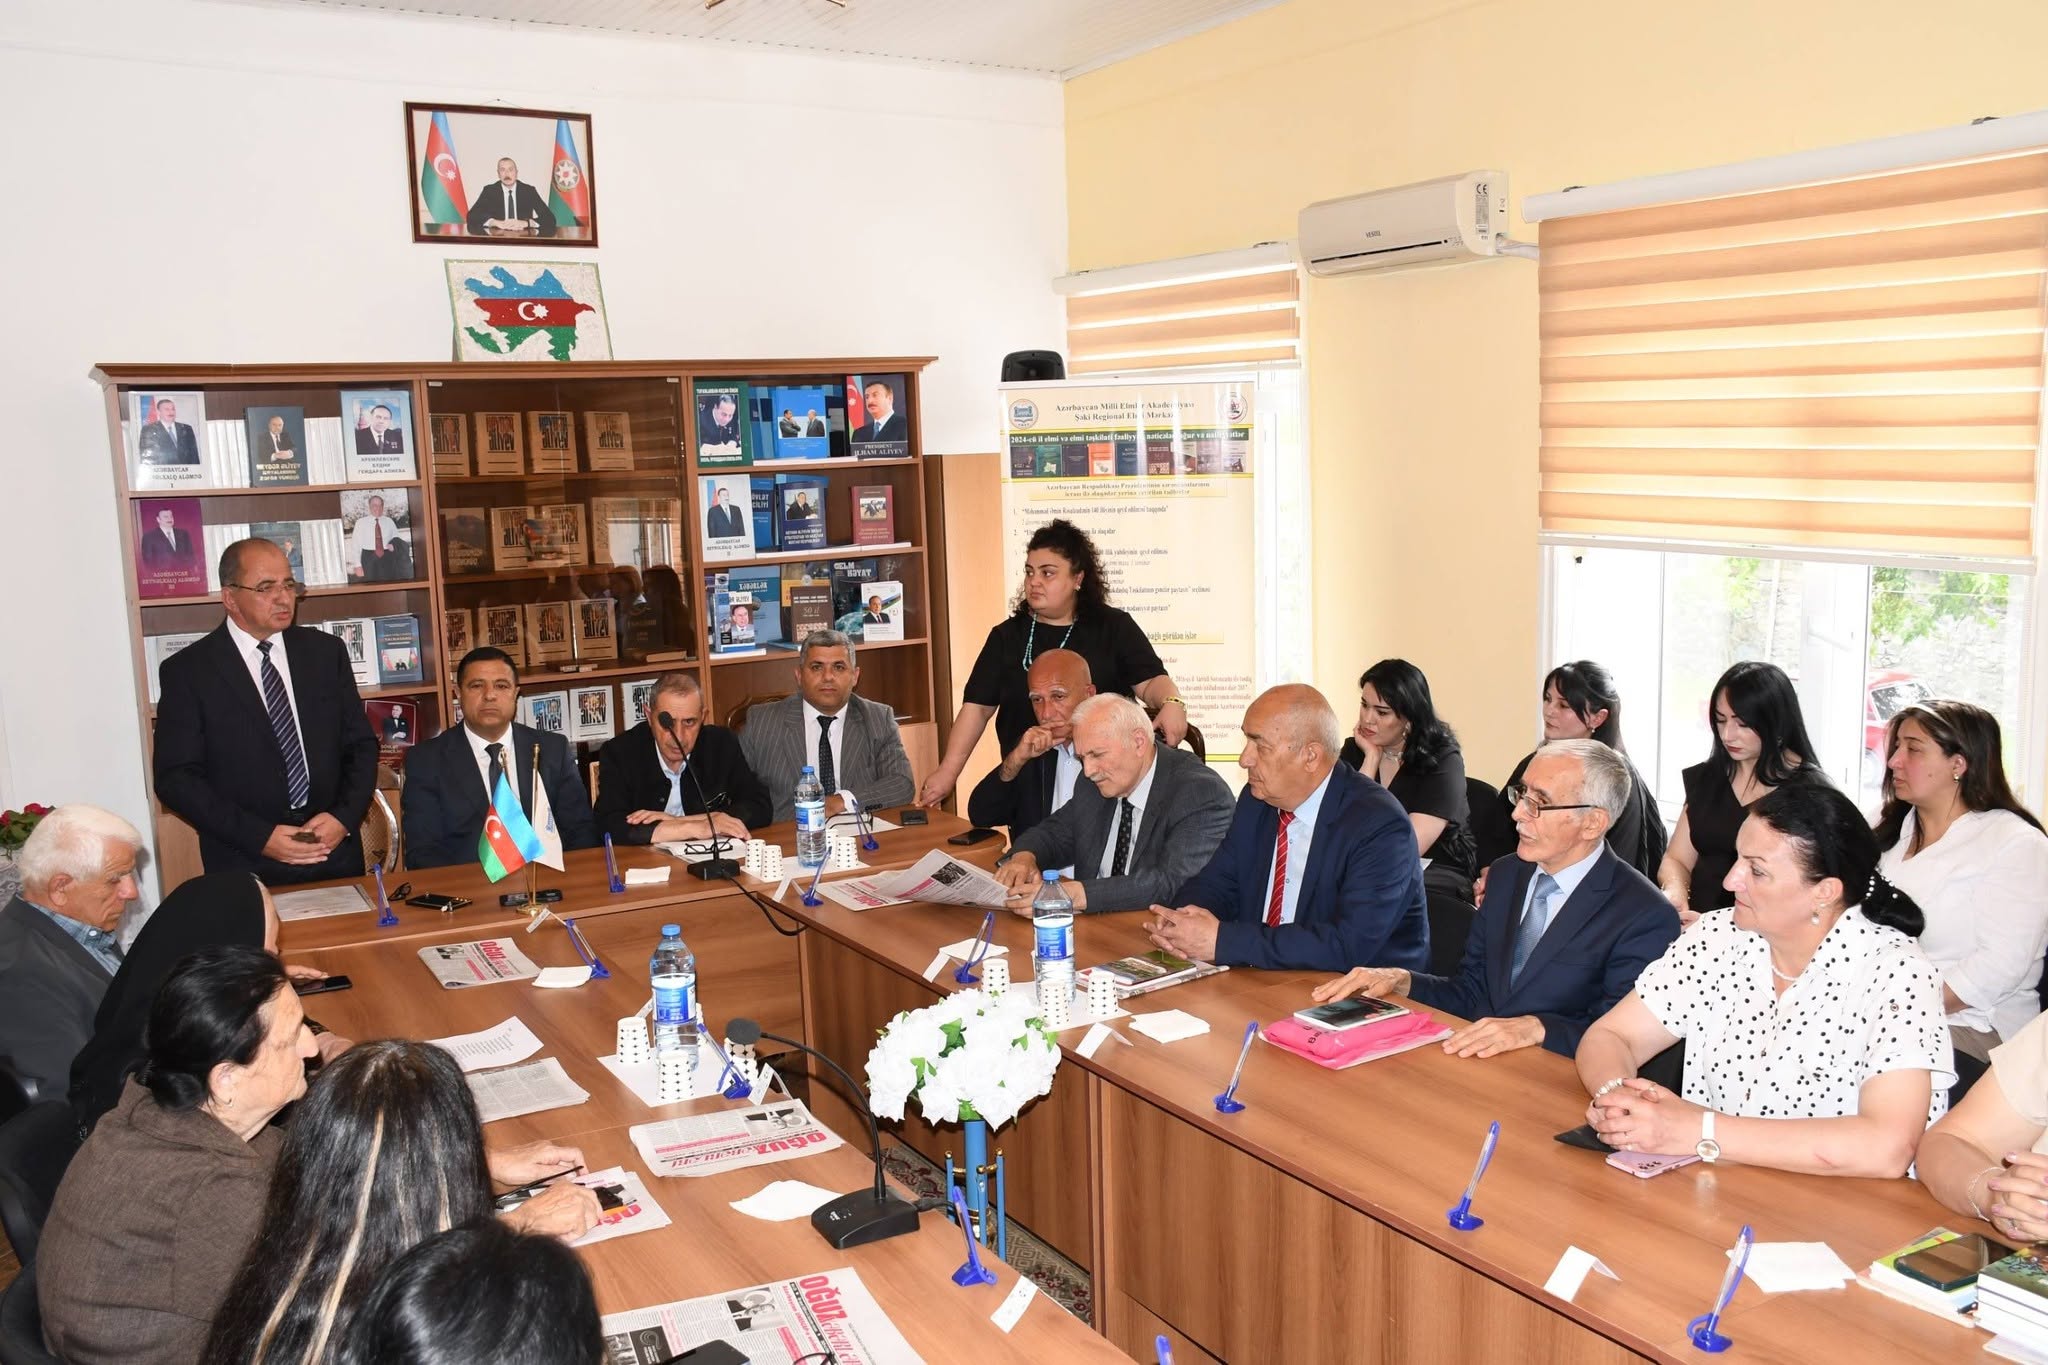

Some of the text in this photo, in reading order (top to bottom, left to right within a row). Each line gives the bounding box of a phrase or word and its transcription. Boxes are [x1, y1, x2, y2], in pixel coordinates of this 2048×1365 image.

[1120, 402, 1145, 410] Elmlr
[756, 1131, 827, 1155] OĞUZ
[799, 1275, 848, 1322] OĞUZ
